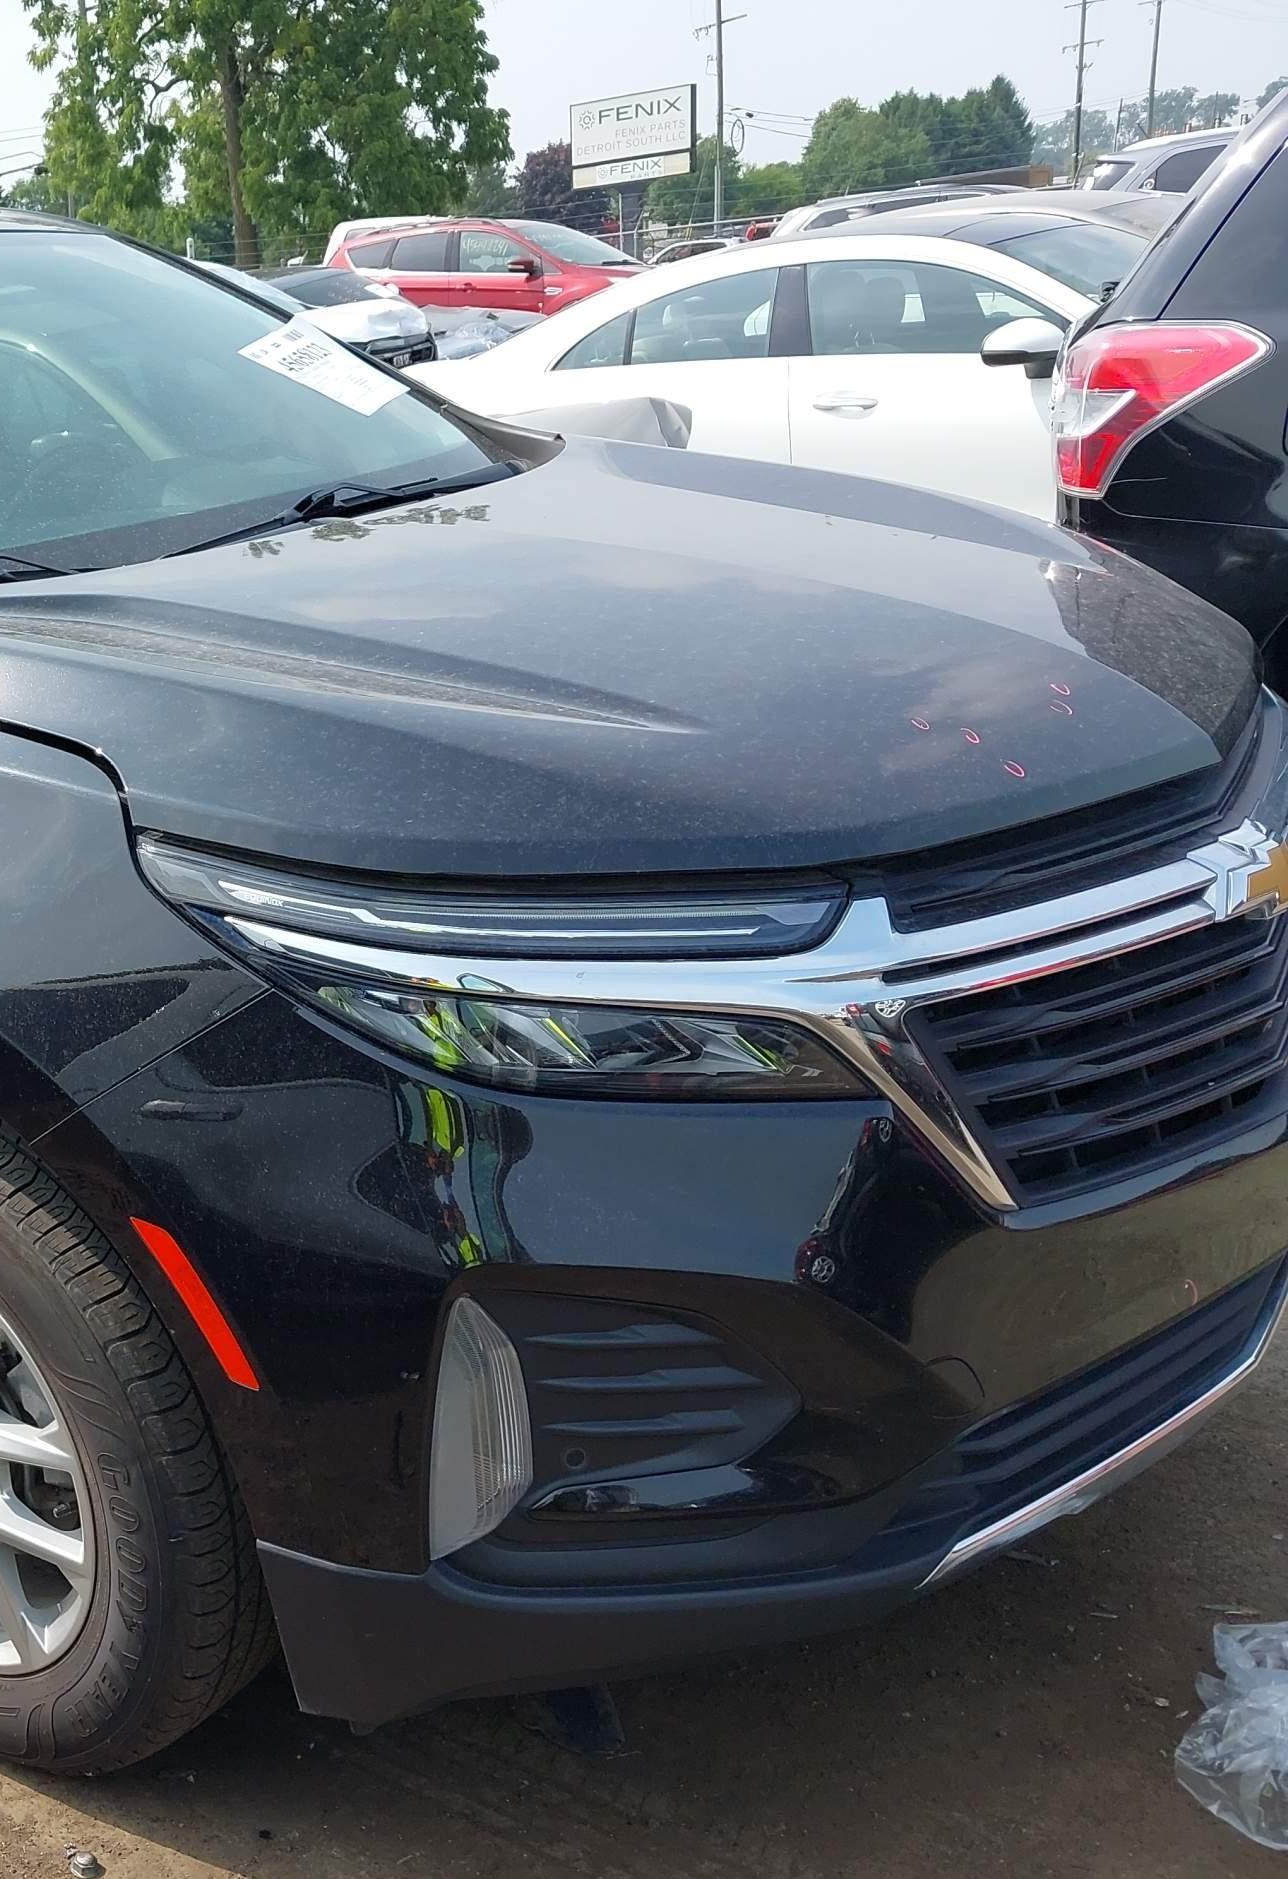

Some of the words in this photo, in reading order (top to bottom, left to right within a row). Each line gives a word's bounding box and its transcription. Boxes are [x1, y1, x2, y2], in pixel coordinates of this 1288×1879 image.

[599, 97, 682, 124] FENIX
[615, 124, 648, 139] FENIX
[649, 119, 686, 134] PARTS
[576, 141, 622, 157] DETROIT
[625, 135, 662, 149] SOUTH
[665, 130, 687, 143] LLC
[609, 158, 662, 176] FENIX
